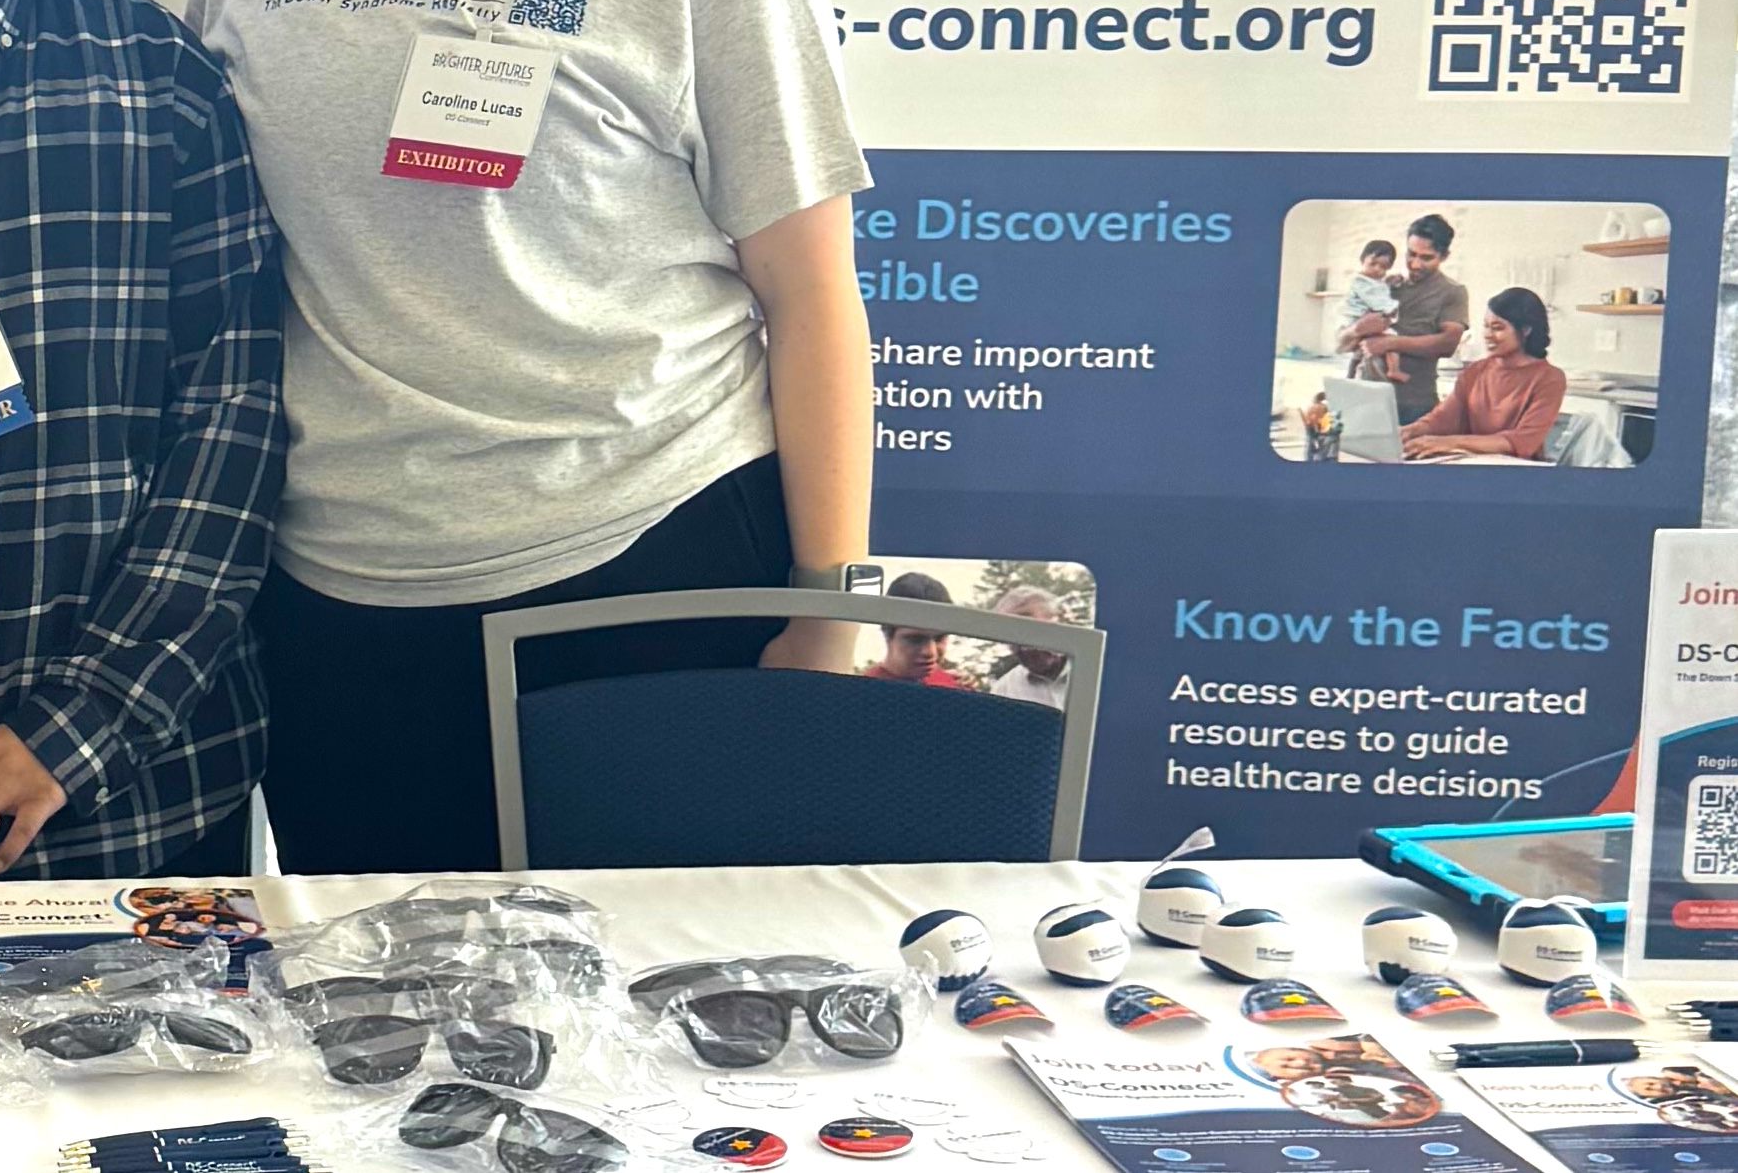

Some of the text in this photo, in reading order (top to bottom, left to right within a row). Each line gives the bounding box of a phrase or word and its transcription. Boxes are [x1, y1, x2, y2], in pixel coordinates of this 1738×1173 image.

[264, 0, 282, 12] The
[483, 59, 536, 81] FUTURES
[421, 90, 524, 119] Caroline Lucas
[397, 149, 507, 178] EXHIBITOR
[916, 197, 1233, 245] Discoveries
[857, 259, 980, 303] sible
[870, 336, 1156, 373] share important
[964, 382, 1043, 411] with
[1678, 581, 1738, 606] Join
[1173, 598, 1611, 654] Know the Facts
[1169, 674, 1589, 717] Access expert-curated
[1168, 721, 1510, 760] resources to guide
[1167, 758, 1543, 800] healthcare decisions
[1030, 1053, 1215, 1074] Join today!
